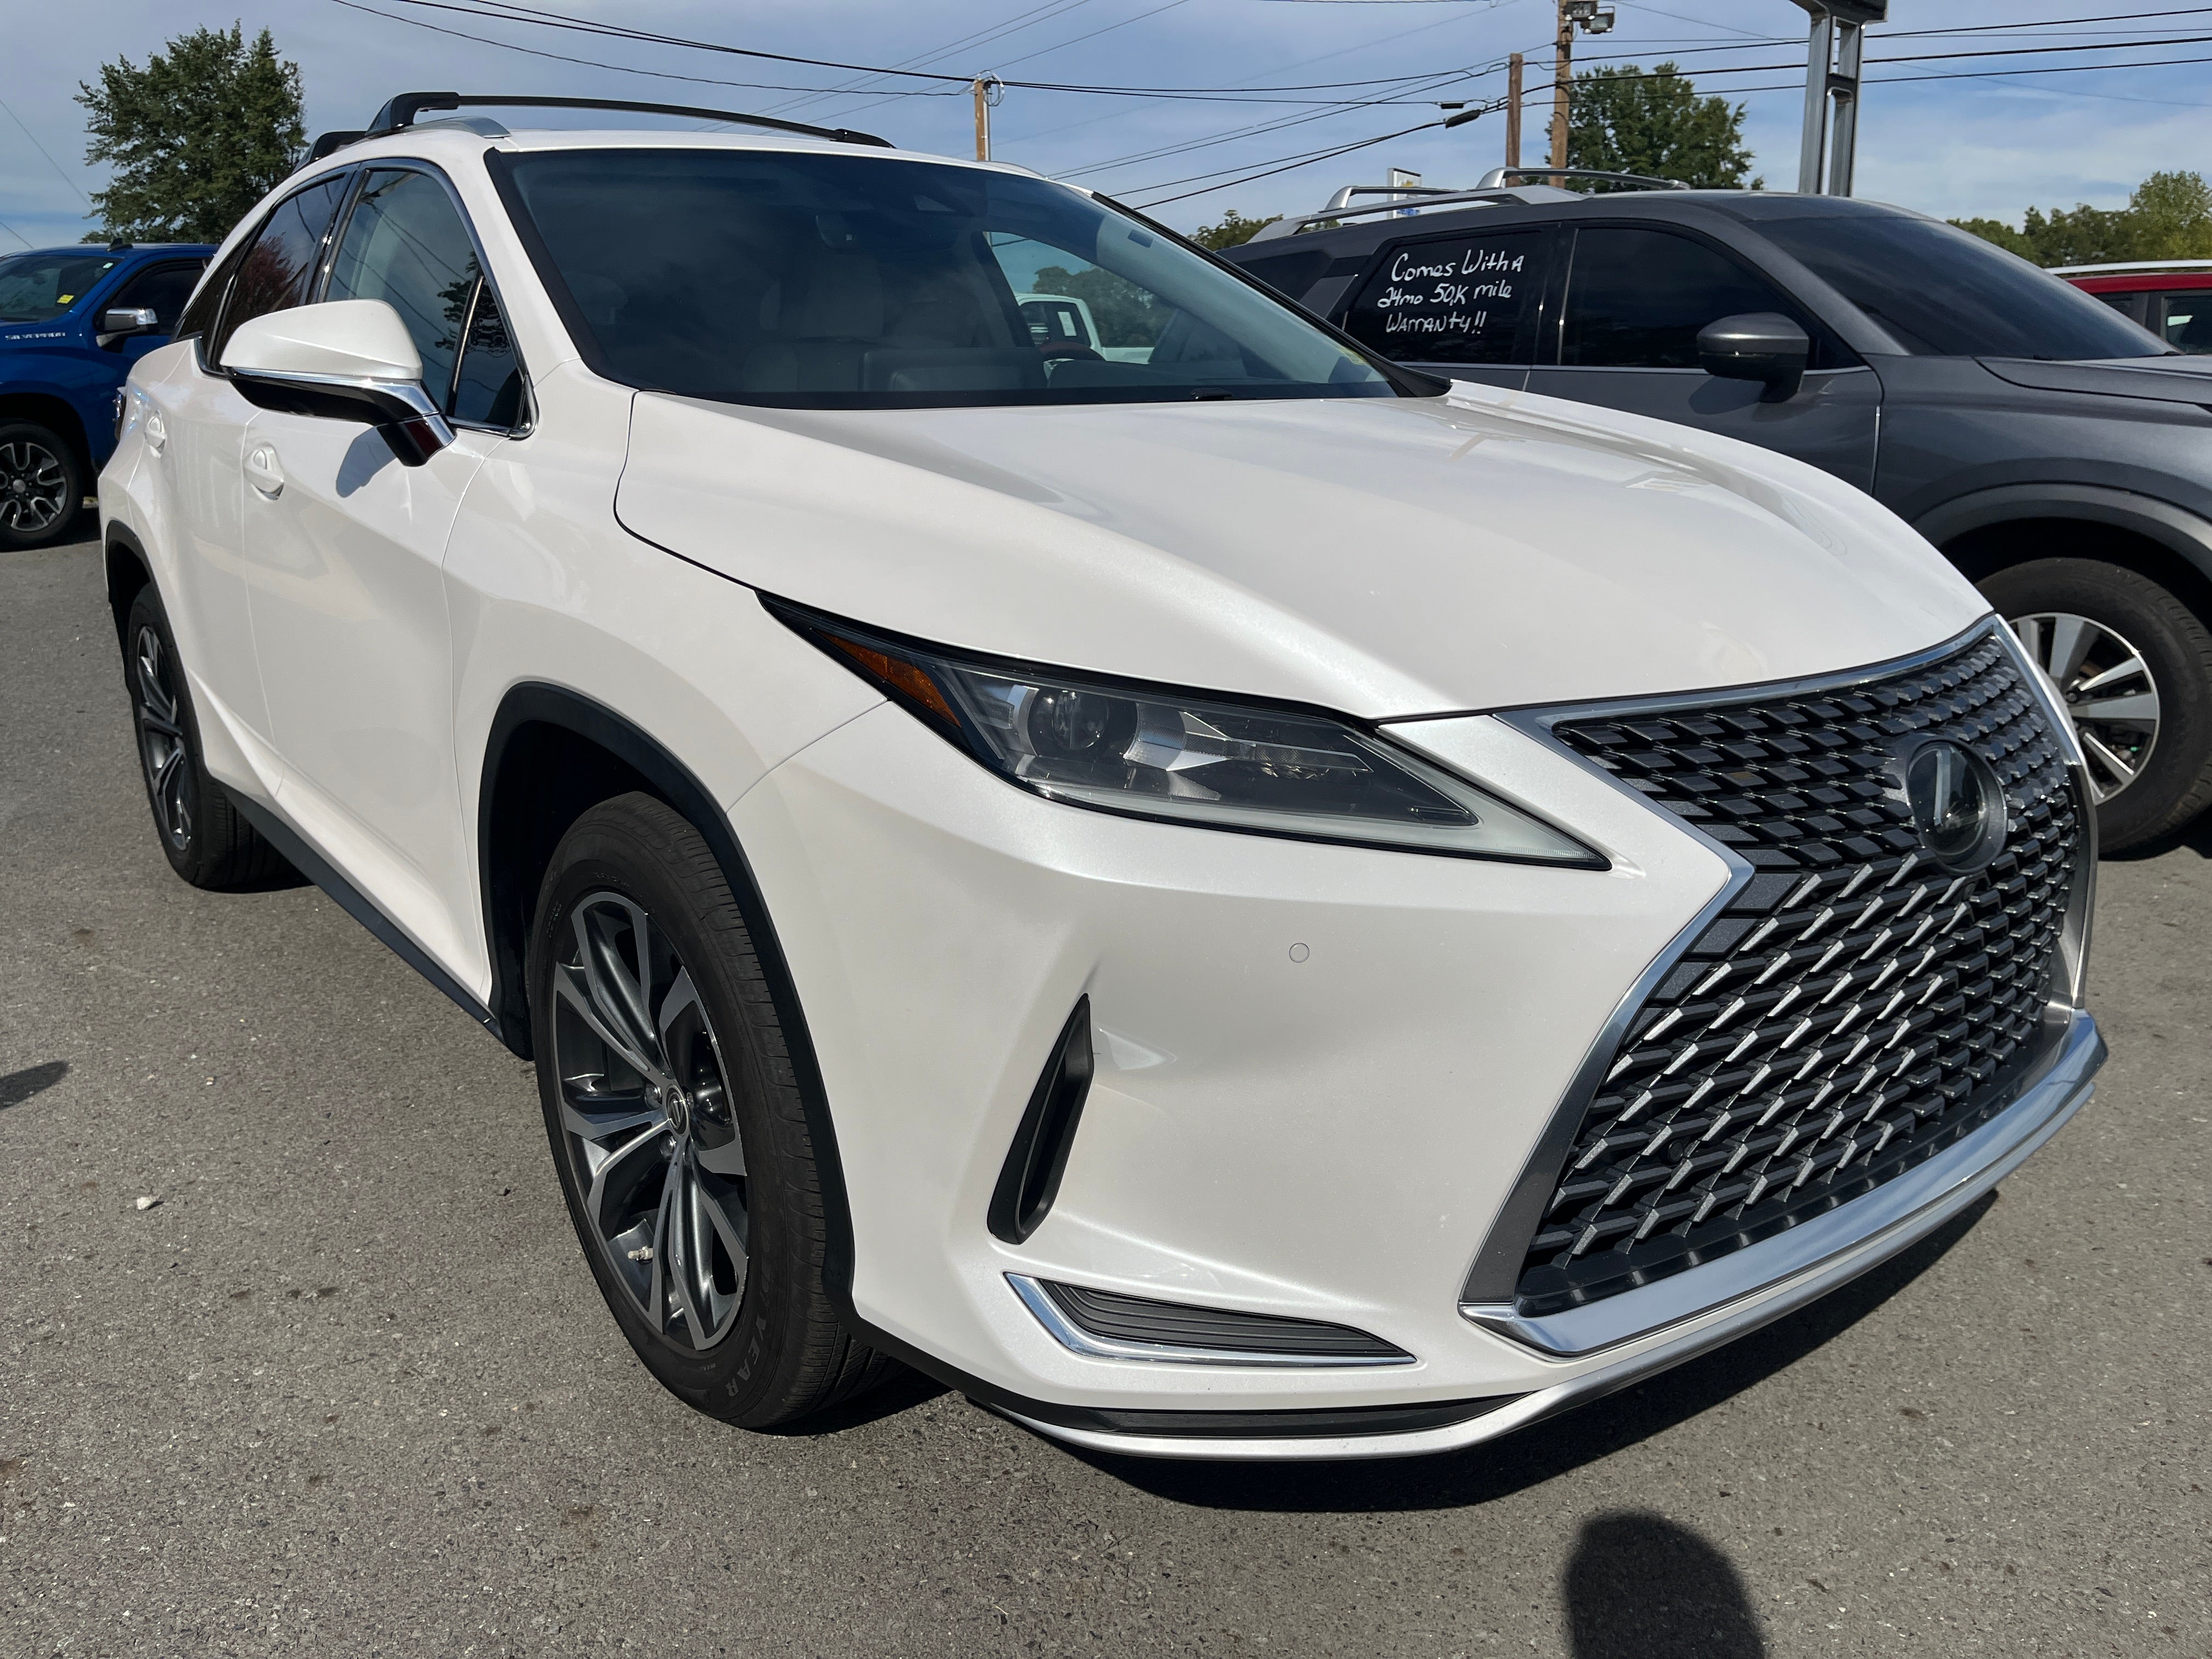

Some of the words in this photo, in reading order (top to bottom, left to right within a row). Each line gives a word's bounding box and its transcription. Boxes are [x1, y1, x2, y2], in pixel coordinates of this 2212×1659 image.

[1391, 252, 1457, 281] Comes
[1461, 249, 1509, 275] With
[1511, 255, 1525, 272] A
[1377, 286, 1424, 308] 24mo
[1473, 279, 1512, 299] mile
